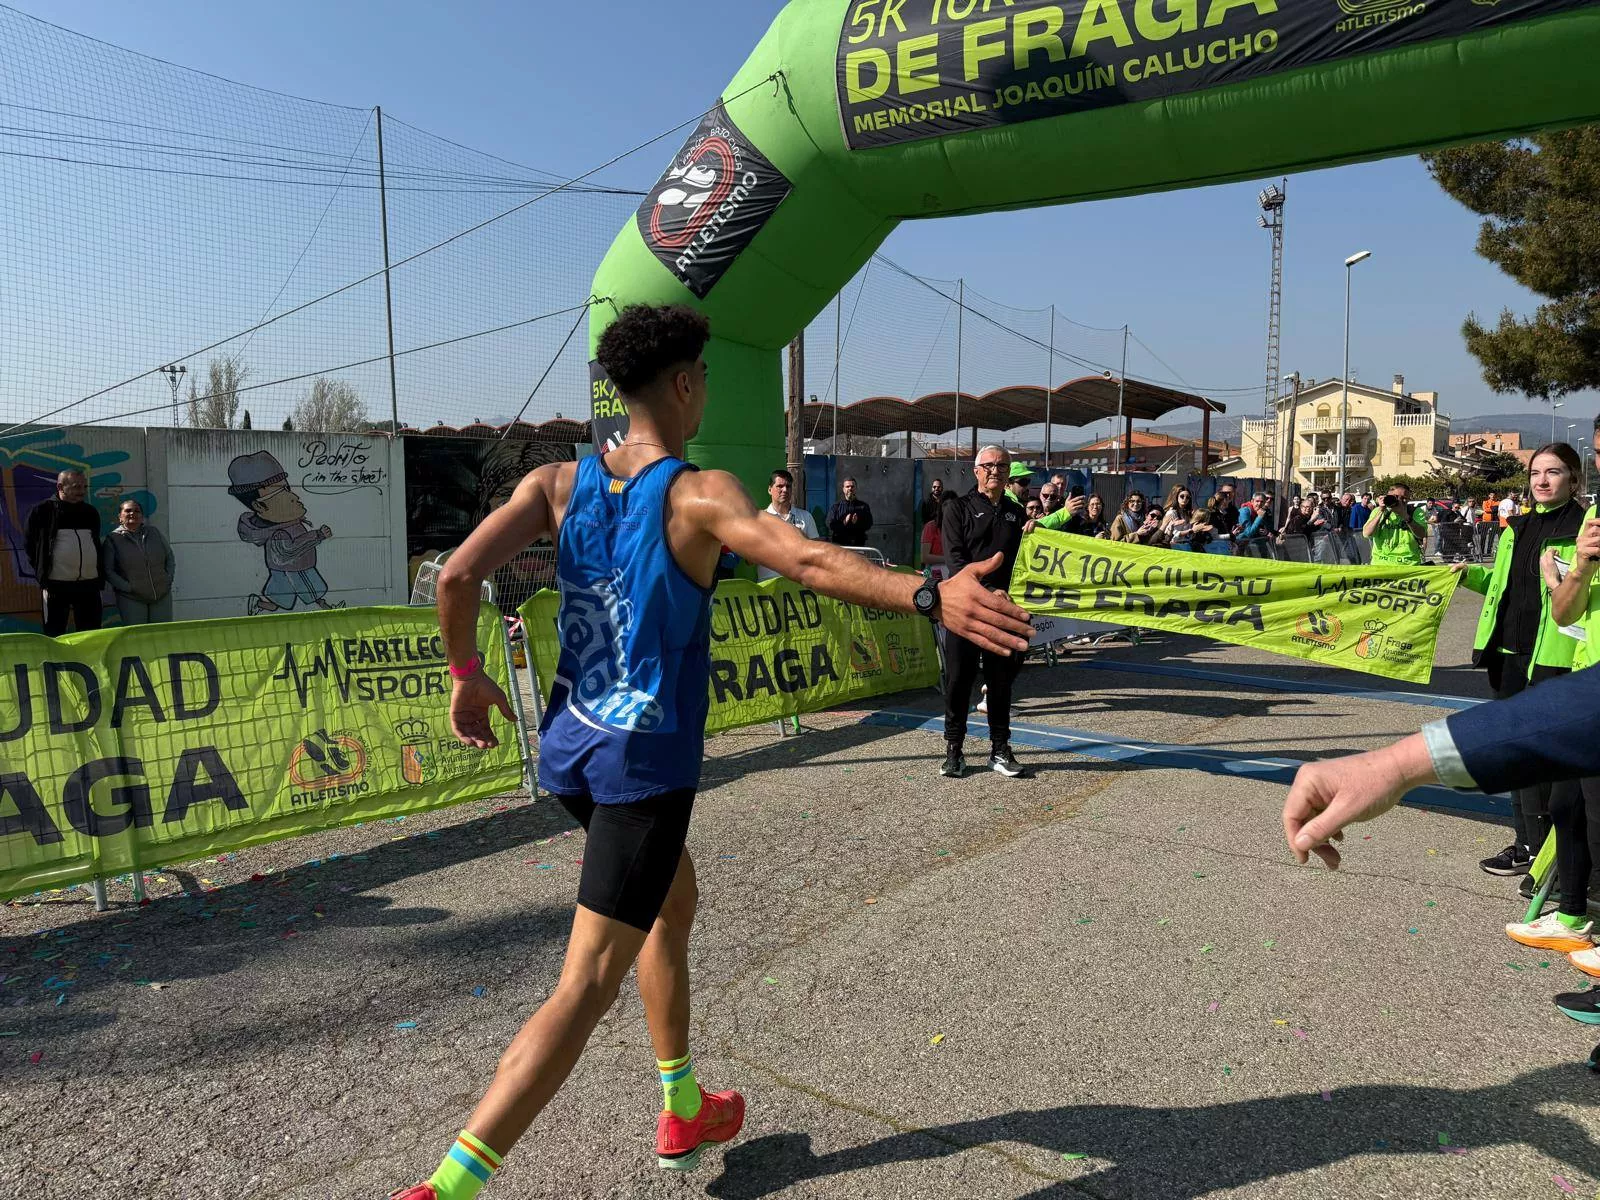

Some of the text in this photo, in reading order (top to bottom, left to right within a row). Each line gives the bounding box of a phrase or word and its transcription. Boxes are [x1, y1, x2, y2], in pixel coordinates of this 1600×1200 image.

[1335, 3, 1427, 33] ATLETISMO
[845, 32, 941, 105] DE
[853, 28, 1279, 134] MEMORIAL JOAQUÍN CALUCHO
[675, 171, 758, 272] ATLETISMO
[593, 398, 630, 420] FRA
[1029, 543, 1072, 579] 5K
[1079, 553, 1137, 589] 10K
[1023, 580, 1082, 610] DE
[1347, 591, 1425, 615] SPORT
[710, 589, 822, 641] CIUDAD
[343, 634, 446, 665] FARTLEC
[1291, 634, 1336, 651] ATLETISMO
[1385, 636, 1413, 651] Fraga
[356, 671, 450, 702] SPOR
[709, 643, 841, 704] RAGA
[290, 781, 370, 807] ATLETISMO
